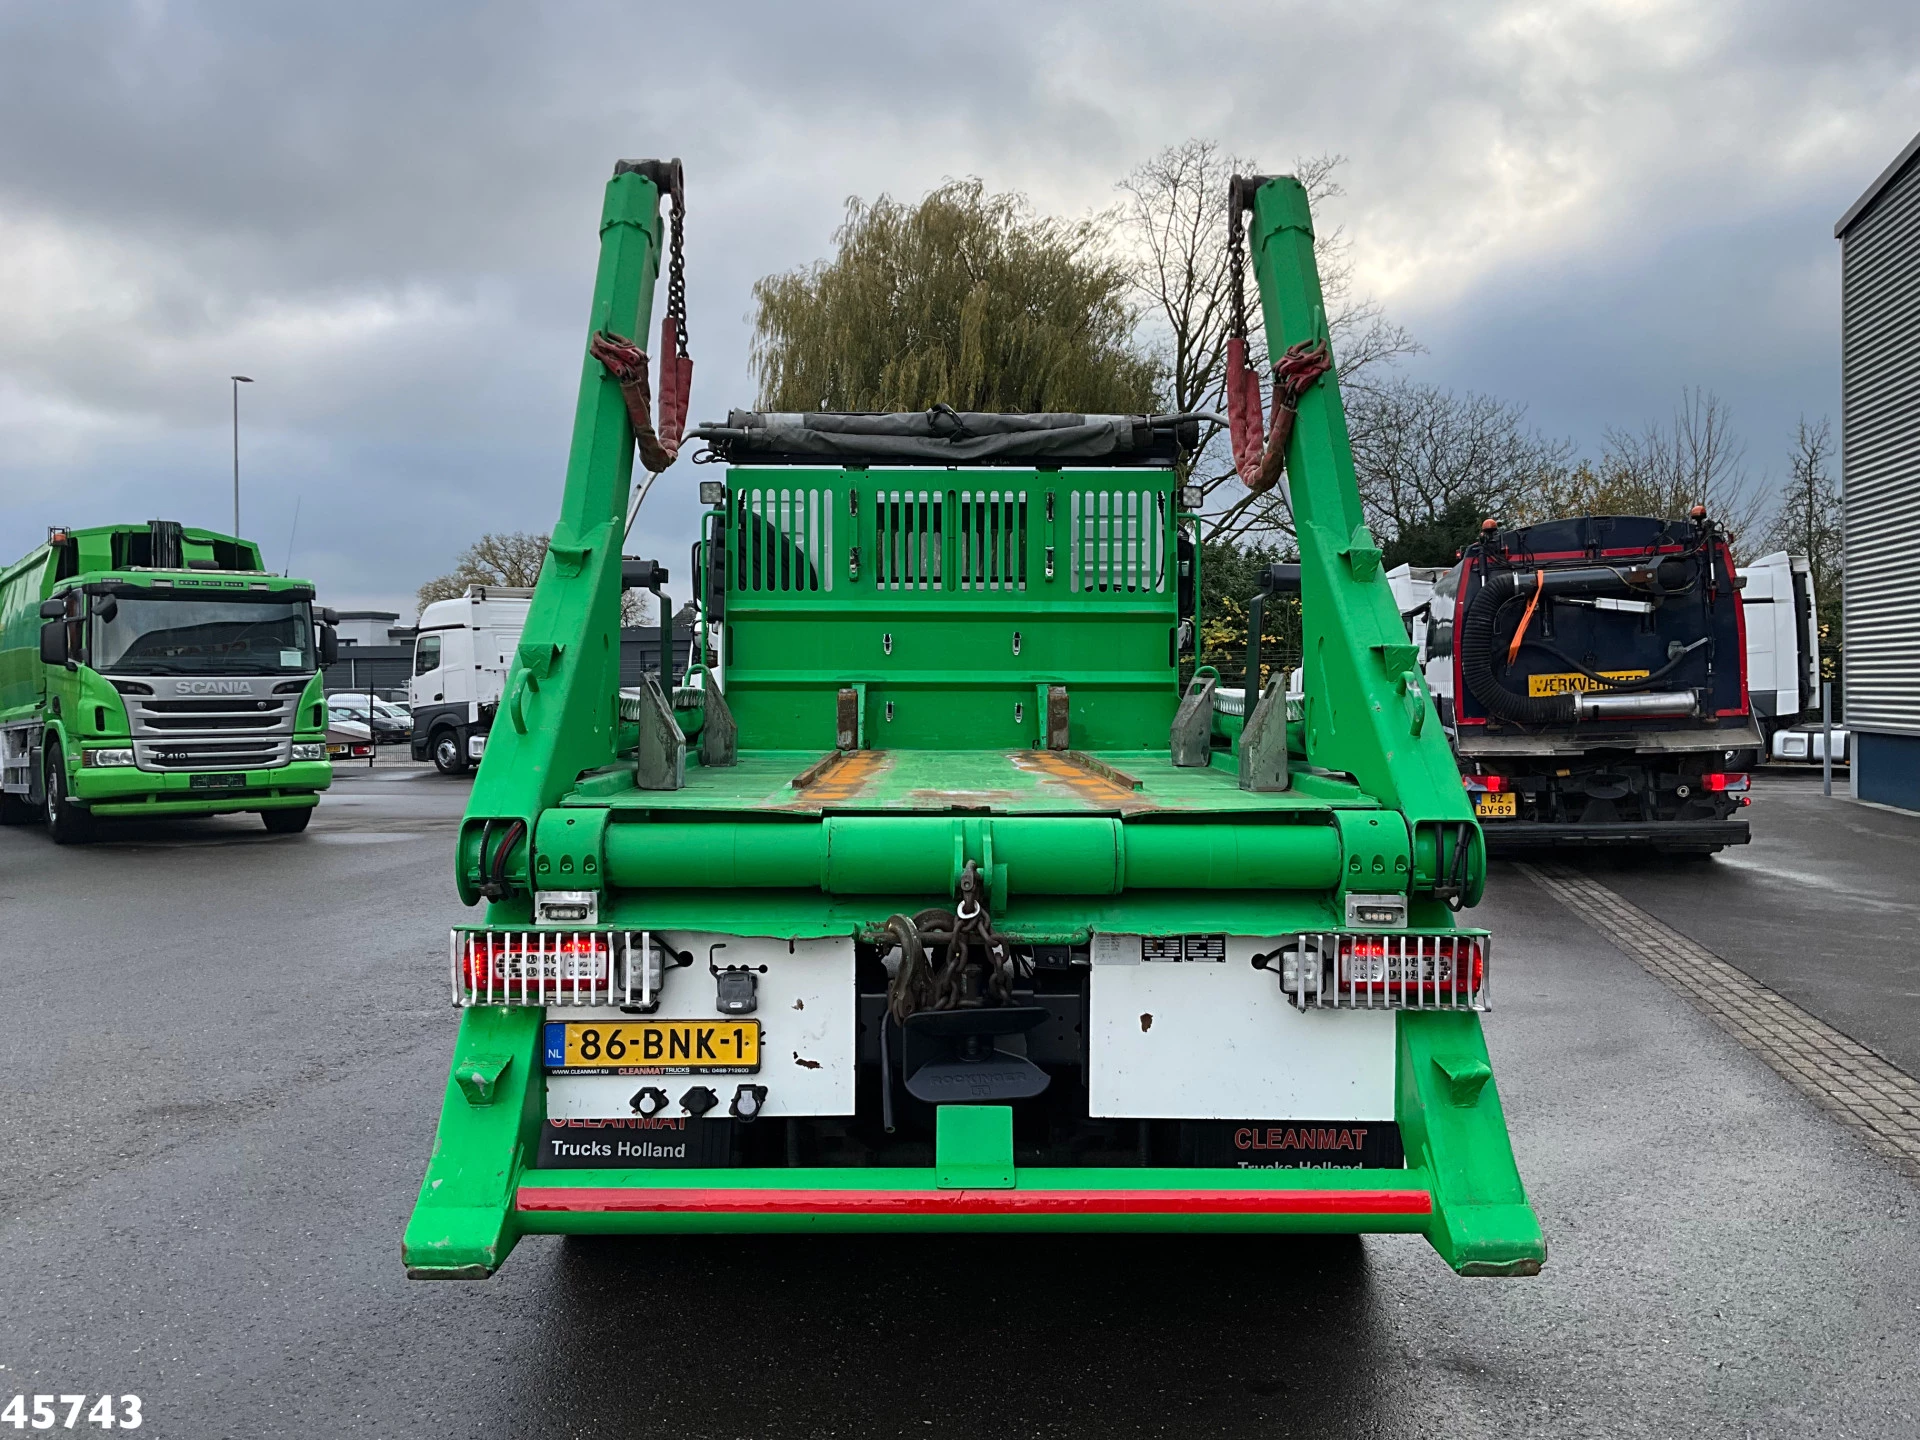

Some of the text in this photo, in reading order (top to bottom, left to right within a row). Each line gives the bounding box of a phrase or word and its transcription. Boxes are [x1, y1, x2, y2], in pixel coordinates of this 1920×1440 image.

[176, 681, 252, 694] SCANIA
[1490, 794, 1504, 803] BZ
[1480, 805, 1512, 815] BV-89
[580, 1028, 743, 1061] 86-BNK-1
[548, 1049, 562, 1059] NL
[618, 1067, 665, 1075] CLEANMAT
[1234, 1127, 1368, 1150] CLEANMAT
[551, 1140, 686, 1158] Trucks Holland
